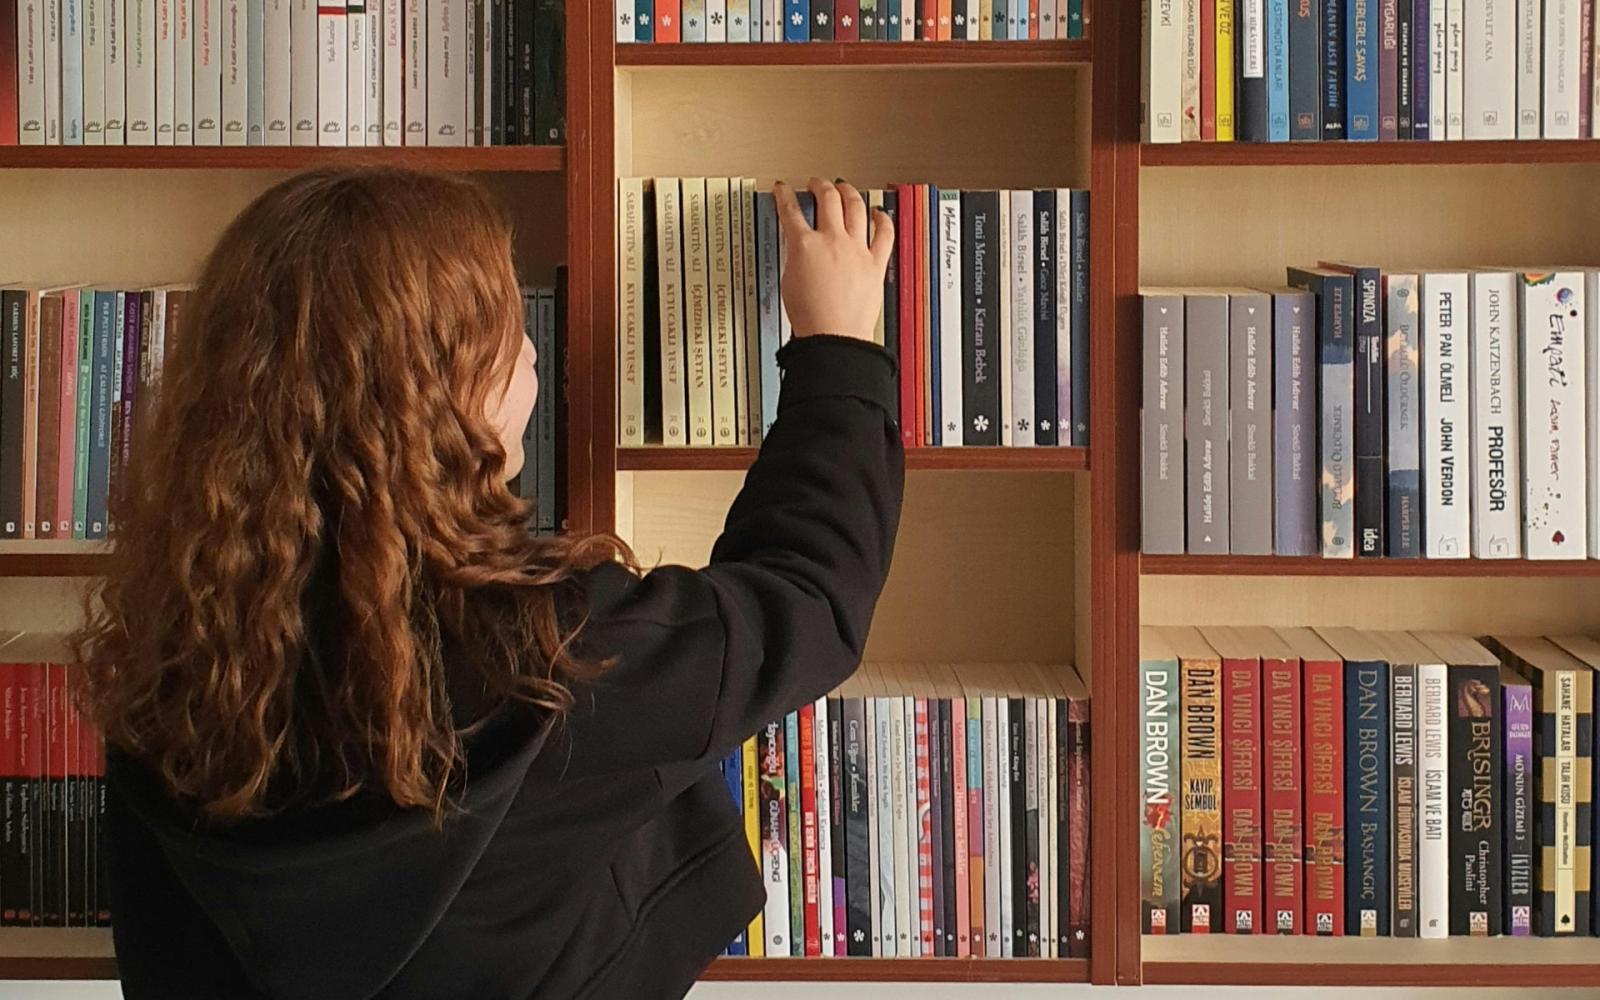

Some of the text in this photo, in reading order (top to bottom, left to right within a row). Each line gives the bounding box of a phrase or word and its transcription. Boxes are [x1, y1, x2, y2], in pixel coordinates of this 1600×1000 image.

[1220, 7, 1230, 19] VE
[1353, 0, 1367, 81] ERLERLE SAVAŞ
[1485, 40, 1493, 61] ANA
[1017, 244, 1028, 274] Birsel
[1039, 236, 1049, 260] Birsel
[1076, 238, 1086, 263] Birsel
[974, 213, 987, 385] Toni Morrison Katran Bebek
[1076, 271, 1086, 303] Kediler
[1334, 286, 1343, 302] LEE
[1362, 279, 1377, 323] SPINOZA
[11, 302, 20, 331] CARMEN
[626, 283, 635, 345] KUYUCAKLI
[690, 284, 704, 344] İÇİMİZDEKİ
[714, 284, 727, 344] İÇİMİZDEKİ
[1333, 303, 1344, 338] HARPER
[11, 332, 20, 363] LAFORET
[1160, 326, 1169, 356] Halide
[1248, 326, 1257, 356] Halide
[1293, 326, 1302, 356] Halide
[1542, 313, 1568, 387] Empati
[627, 349, 635, 385] YUSUF
[693, 347, 704, 388] ŞEYTAN
[717, 347, 728, 388] ŞEYTAN
[1160, 357, 1169, 378] Edib
[1248, 357, 1257, 378] Edib
[1293, 357, 1302, 378] Edib
[1160, 379, 1169, 411] Adıvar
[1248, 379, 1257, 411] Adıvar
[1293, 379, 1302, 411] Adıvar
[1439, 292, 1455, 506] PETER PAN ÖLMELİ JOHN VERDON
[1488, 289, 1507, 512] JOHN KATZENBACH PROFESÖR
[1160, 452, 1169, 480] Bakkal
[1204, 440, 1213, 471] Adıvar
[1248, 452, 1257, 480] Bakkal
[1293, 452, 1302, 480] Bakkal
[1204, 472, 1213, 492] Edib
[1204, 494, 1213, 523] Halide
[1401, 496, 1410, 530] HARPER
[1363, 528, 1378, 551] idea
[1402, 532, 1410, 549] LEE
[1146, 671, 1170, 717] DAN
[1358, 669, 1378, 720] DAN
[849, 720, 860, 741] Cem
[1187, 669, 1216, 759] DAN BROWN
[1560, 715, 1573, 752] HATALAR
[1146, 721, 1170, 804] BROWN
[1357, 727, 1378, 813] BROWN
[1425, 678, 1444, 841] BERNARD LEWIS İSLAM VE BATI
[1467, 721, 1492, 831] BRISINGR
[1561, 761, 1572, 783] TALİH
[1190, 778, 1214, 793] KAYIP
[1230, 670, 1256, 896] DA VINCI ŞİFRESİ DAN BROWN
[1269, 670, 1297, 896] DA VINCI ŞİFRESİ DAN BROWN
[1310, 674, 1337, 899] DA VINCI ŞİFRESİ DAN BROWN
[1394, 675, 1416, 910] BERNARD LEWIS İSLAM DÜNYASINDA MUSEVİLER
[1184, 795, 1217, 811] SEMBOL
[1514, 798, 1527, 834] GİZEMİ
[1464, 854, 1480, 893] Paolini
[1474, 840, 1491, 905] Christopher
[1511, 854, 1531, 896] İKİZLER
